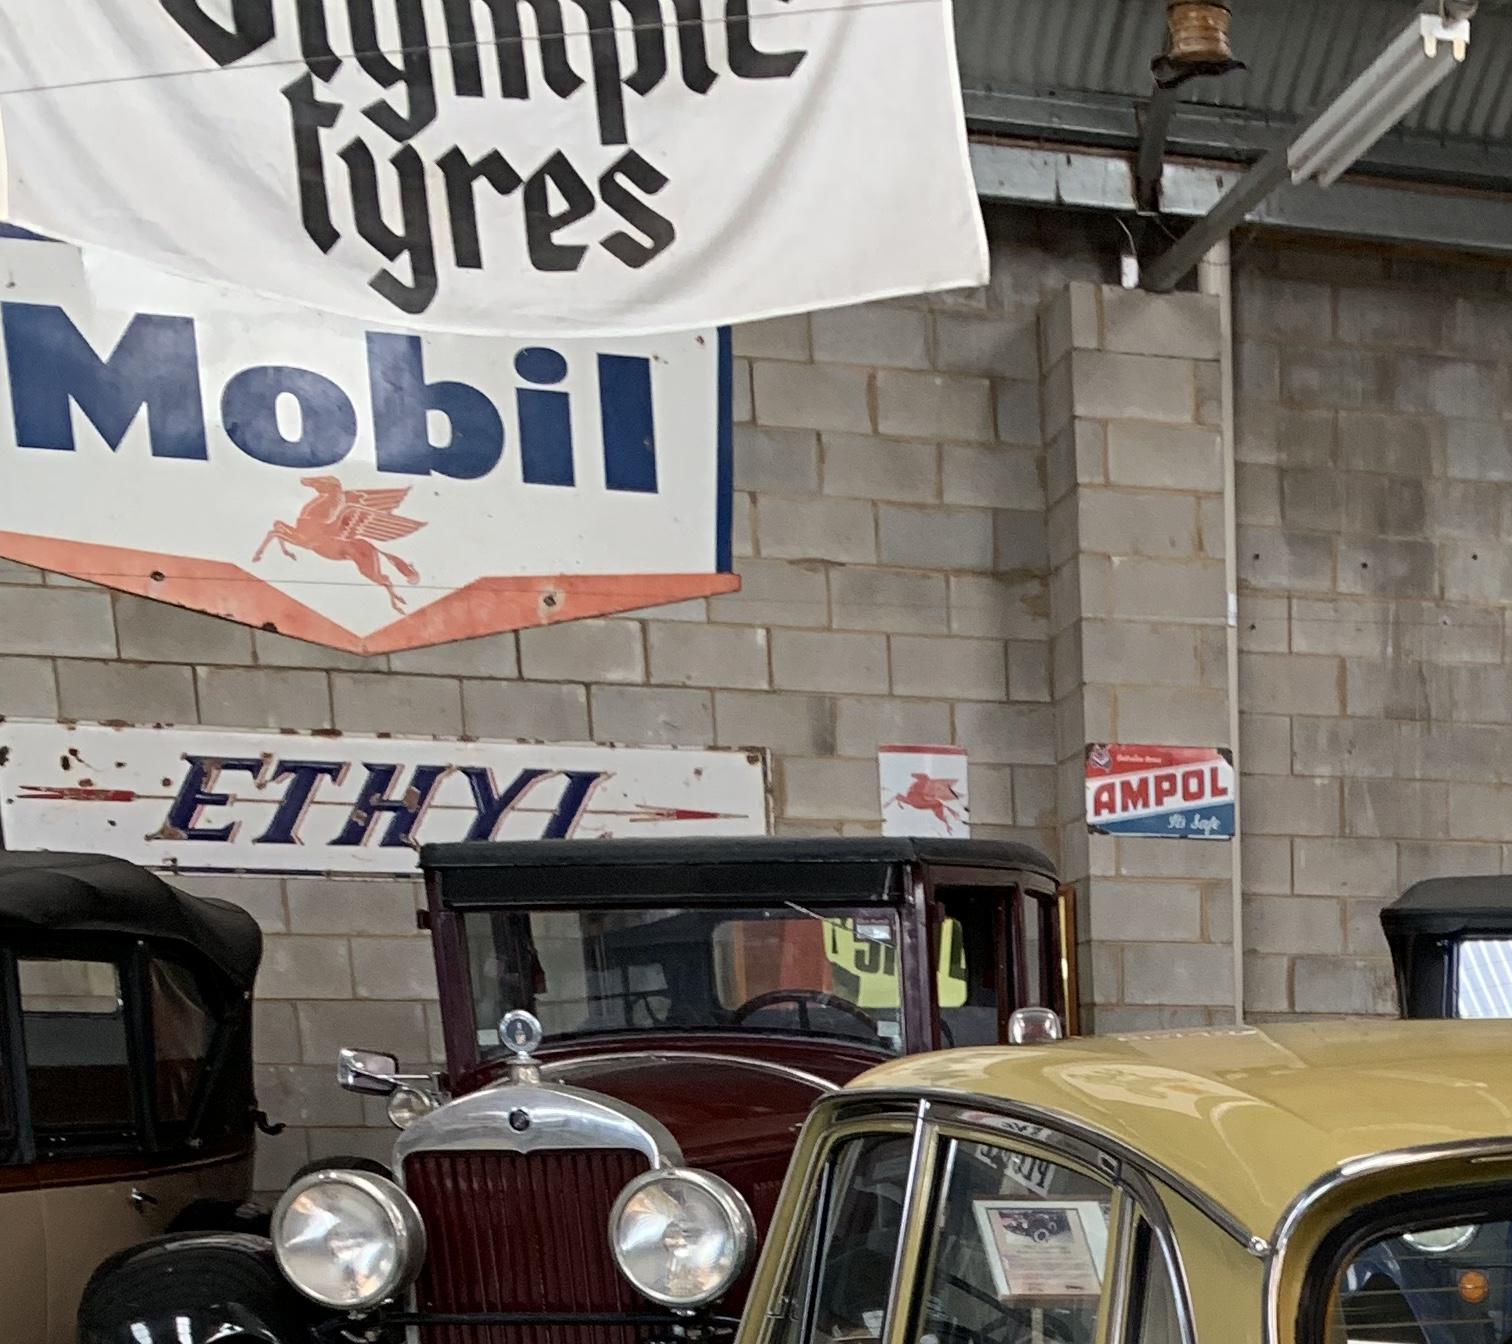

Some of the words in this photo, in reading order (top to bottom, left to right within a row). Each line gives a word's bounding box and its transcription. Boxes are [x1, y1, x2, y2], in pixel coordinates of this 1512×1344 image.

[280, 70, 676, 314] tyres
[0, 301, 659, 494] Mobil
[1093, 766, 1229, 816] AMPOL
